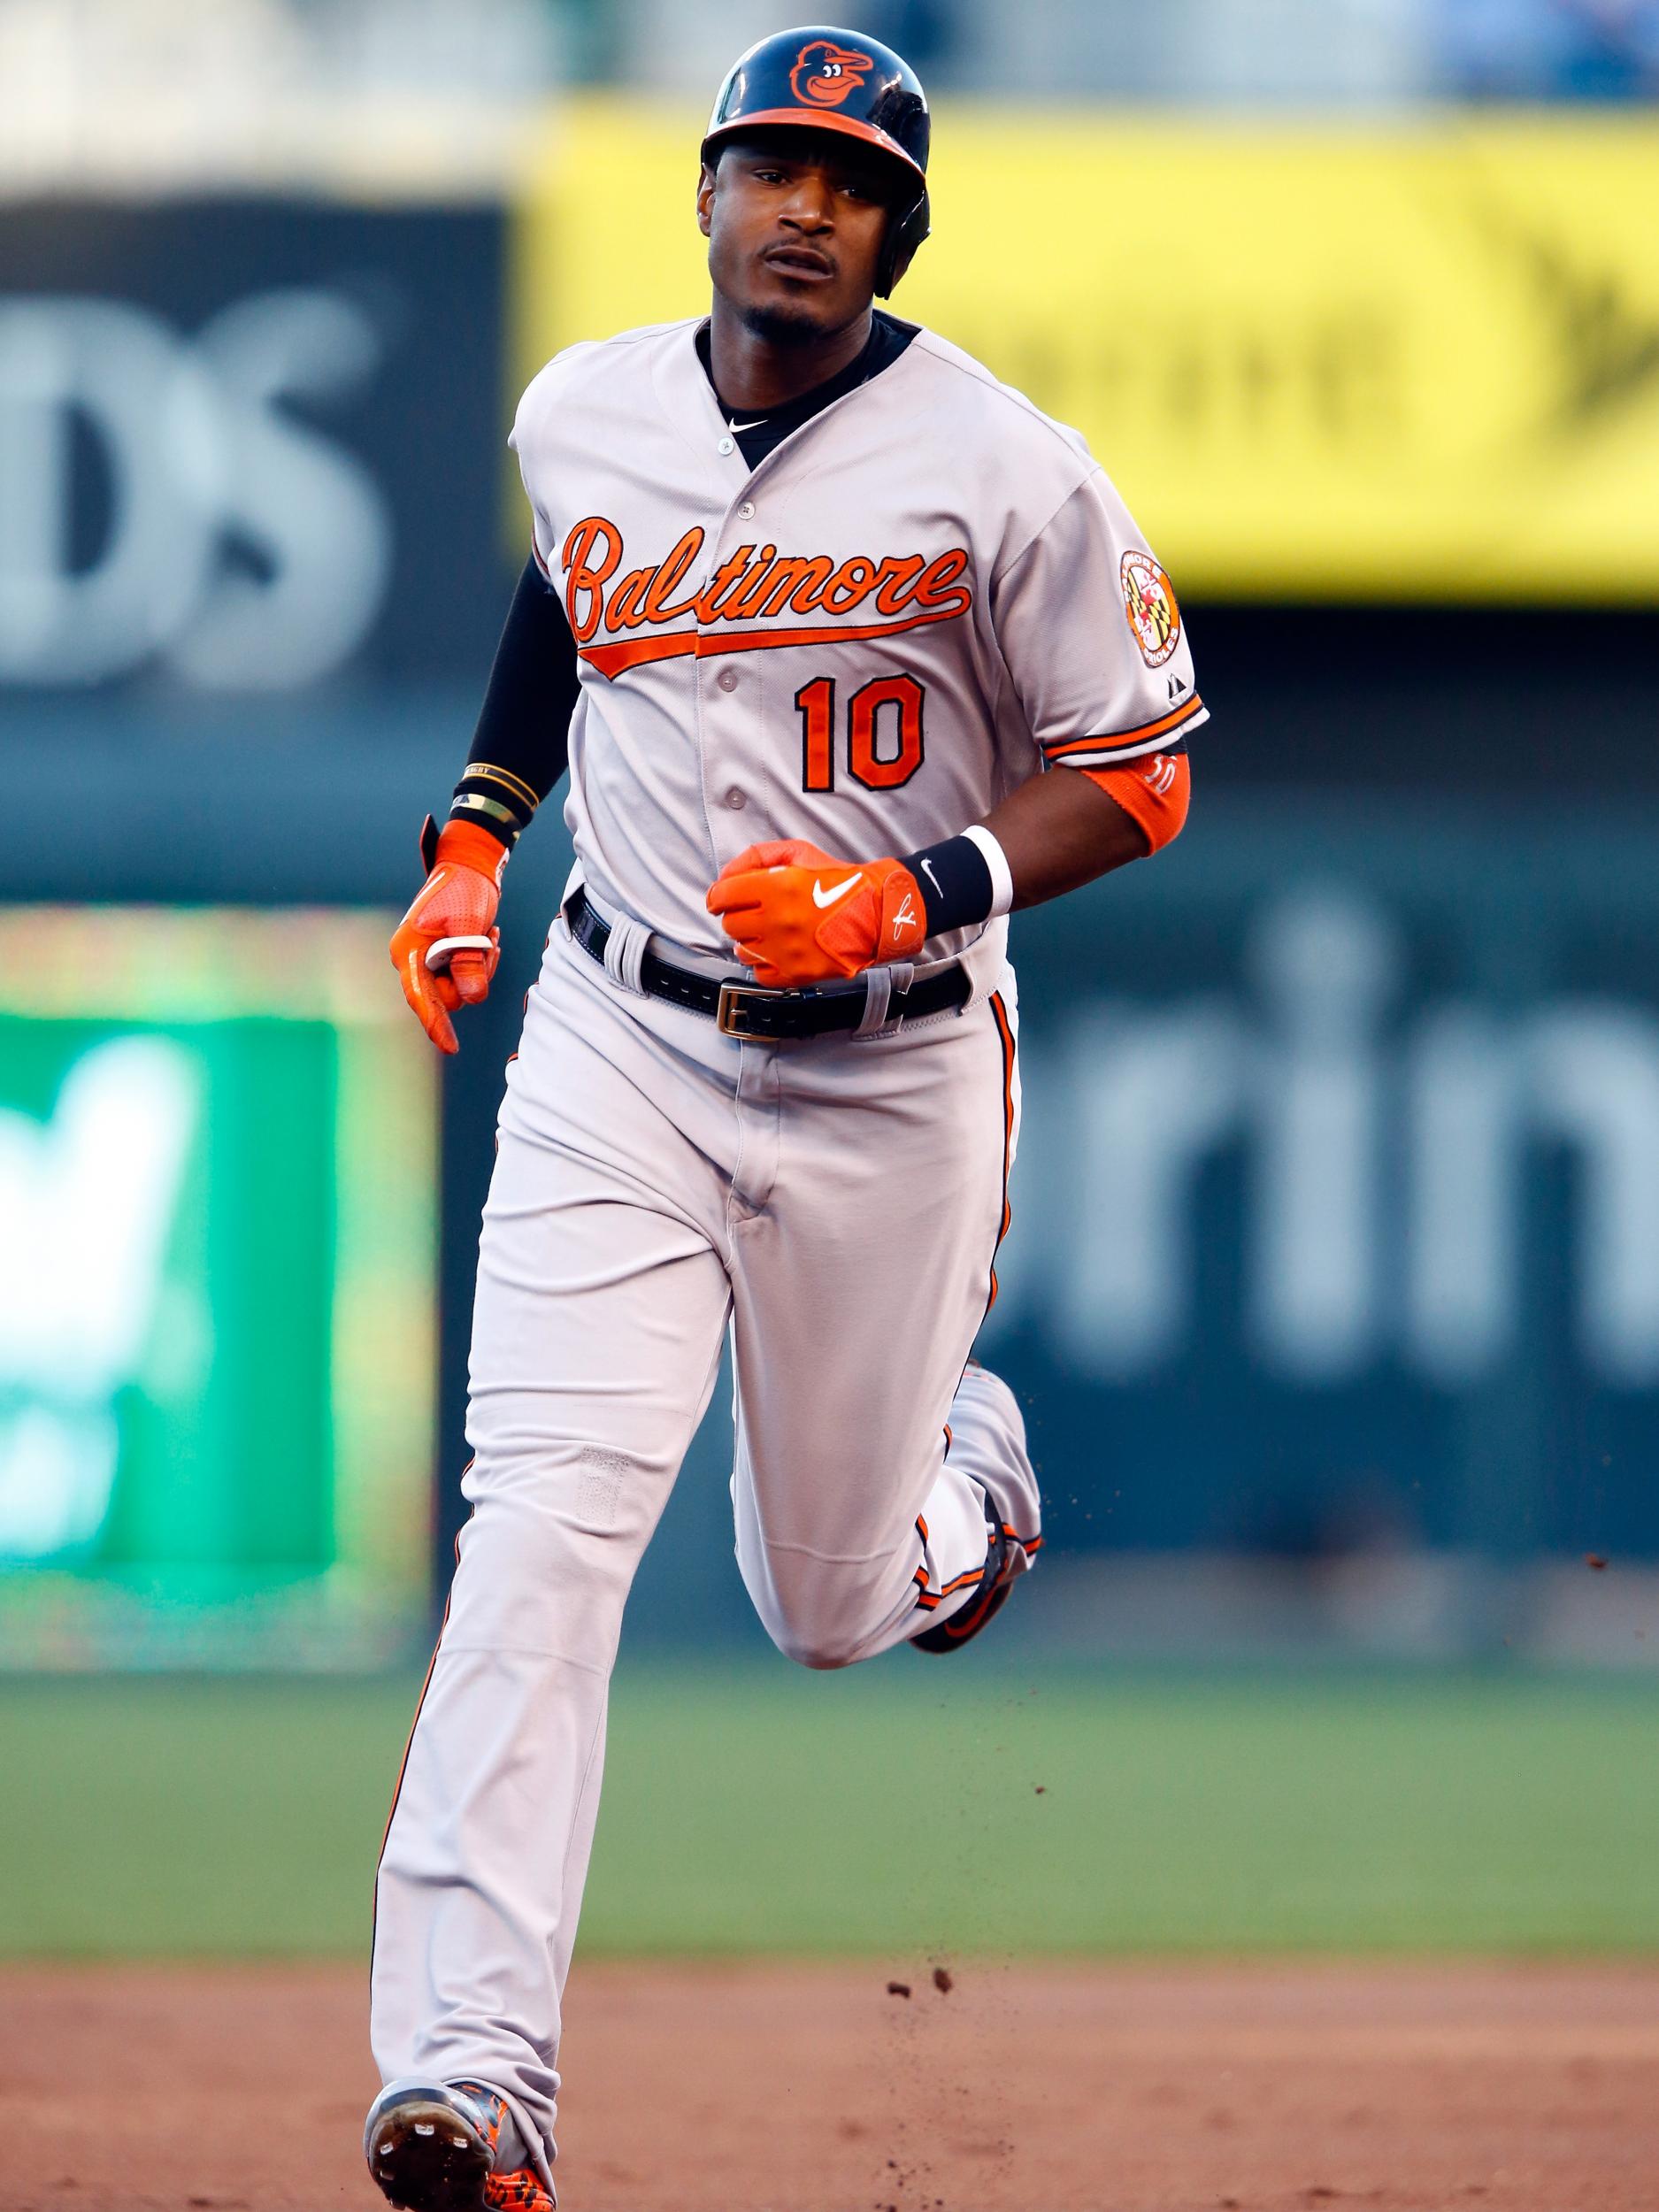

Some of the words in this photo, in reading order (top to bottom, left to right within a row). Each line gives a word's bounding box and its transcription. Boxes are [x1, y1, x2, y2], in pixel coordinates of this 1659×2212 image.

[563, 516, 972, 646] Baltimore
[795, 672, 925, 793] 10
[1009, 889, 1659, 1382] rin
